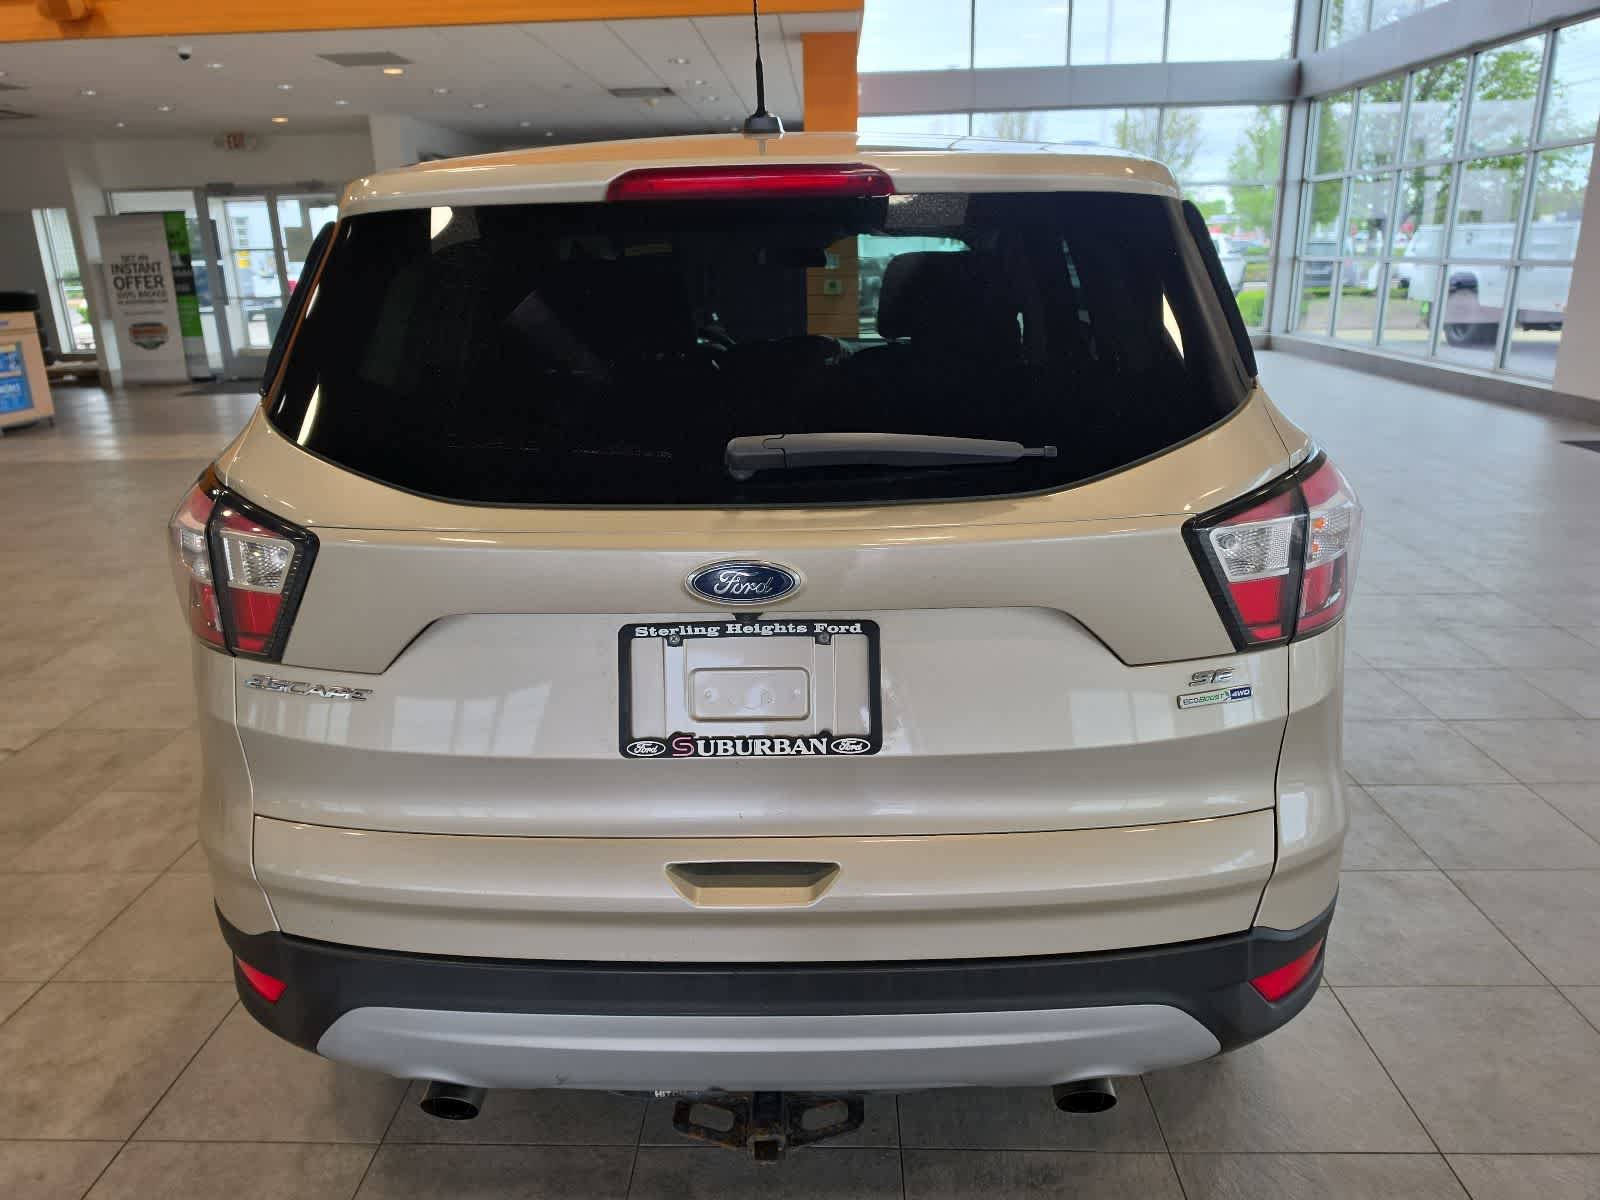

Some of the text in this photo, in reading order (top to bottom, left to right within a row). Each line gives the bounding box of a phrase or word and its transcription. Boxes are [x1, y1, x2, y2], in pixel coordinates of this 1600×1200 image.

[111, 262, 161, 274] INSTANT
[113, 275, 165, 290] OFFER
[713, 570, 773, 595] Ford
[634, 622, 862, 638] Sterling Heights Ford
[1189, 667, 1235, 687] SE
[245, 674, 373, 700] ESCAPE
[1231, 688, 1251, 699] 4WD
[632, 742, 659, 755] Ford
[671, 735, 829, 758] SUBURBAN
[837, 738, 864, 753] Ford
